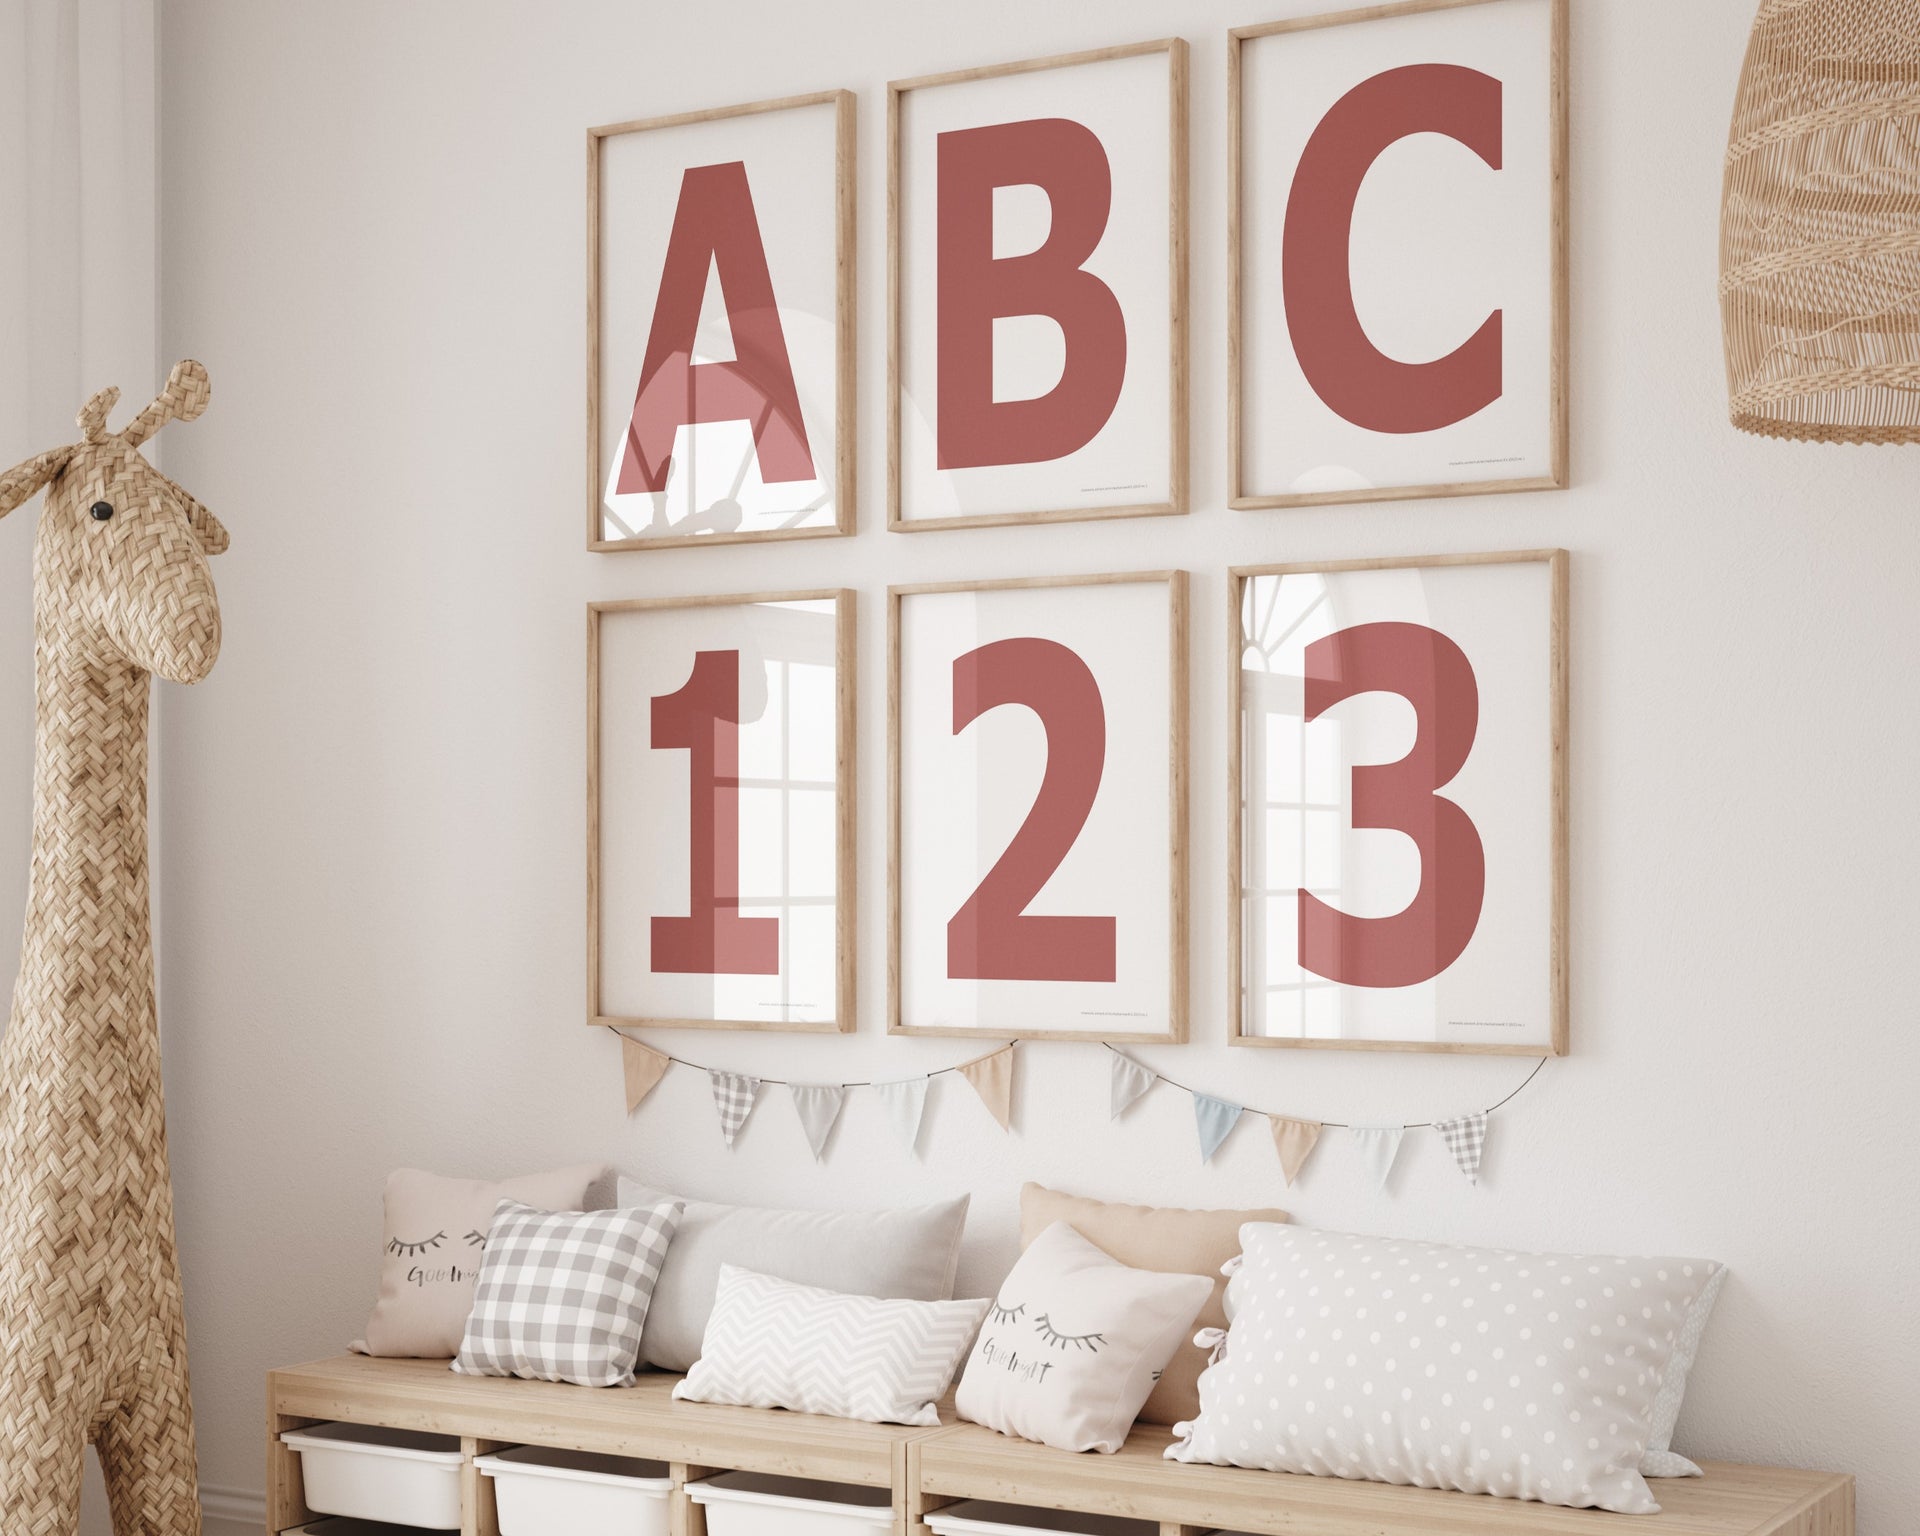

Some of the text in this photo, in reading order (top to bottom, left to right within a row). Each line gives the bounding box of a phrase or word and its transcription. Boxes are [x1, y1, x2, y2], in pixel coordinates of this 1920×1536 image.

[617, 161, 815, 494] A
[937, 118, 1126, 470] B
[1283, 64, 1502, 434] C
[650, 650, 779, 976] 1
[948, 638, 1116, 982] 2
[1298, 622, 1485, 988] 3
